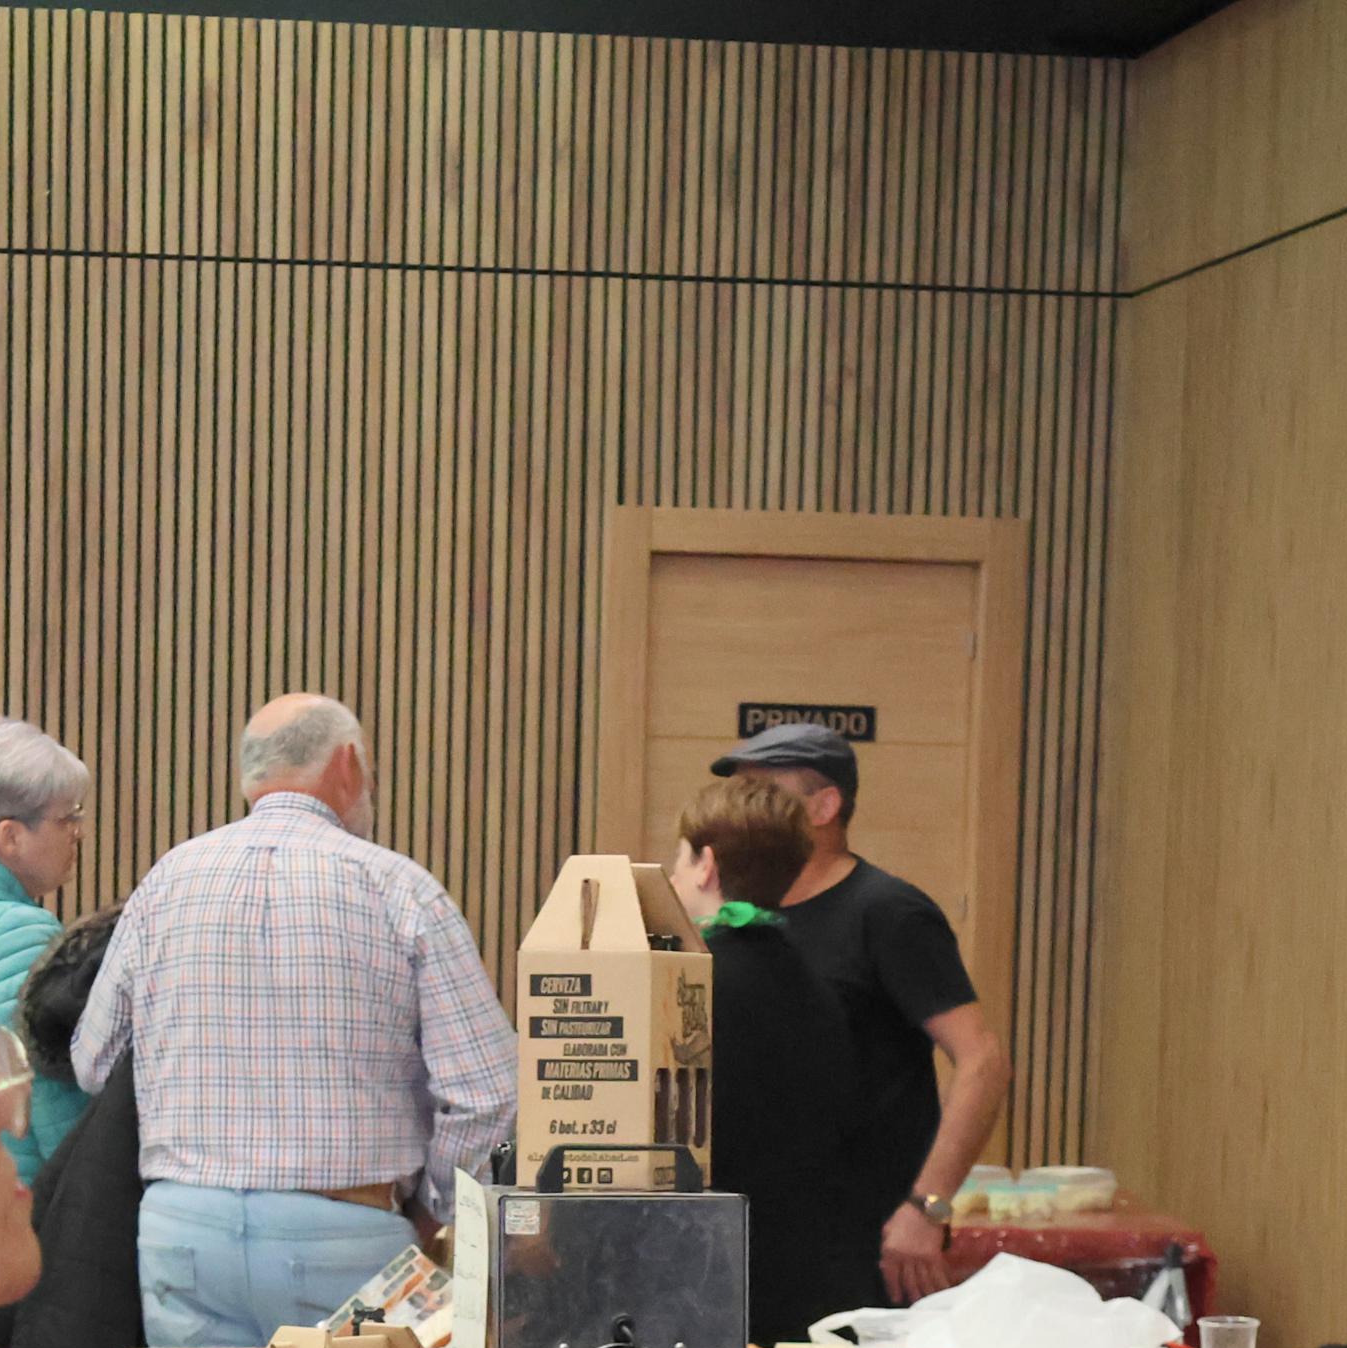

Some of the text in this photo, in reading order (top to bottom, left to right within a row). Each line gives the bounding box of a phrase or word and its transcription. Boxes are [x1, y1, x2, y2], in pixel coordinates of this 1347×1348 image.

[540, 976, 582, 994] CERVEZA
[553, 999, 569, 1014] SIN
[571, 1001, 603, 1014] FILTRAR
[540, 1019, 558, 1036] SIN
[544, 1062, 632, 1079] MATERIAS PRIMAS
[553, 1085, 594, 1100] CALIDAD
[549, 1120, 617, 1135] 6 bot. x 33 cl
